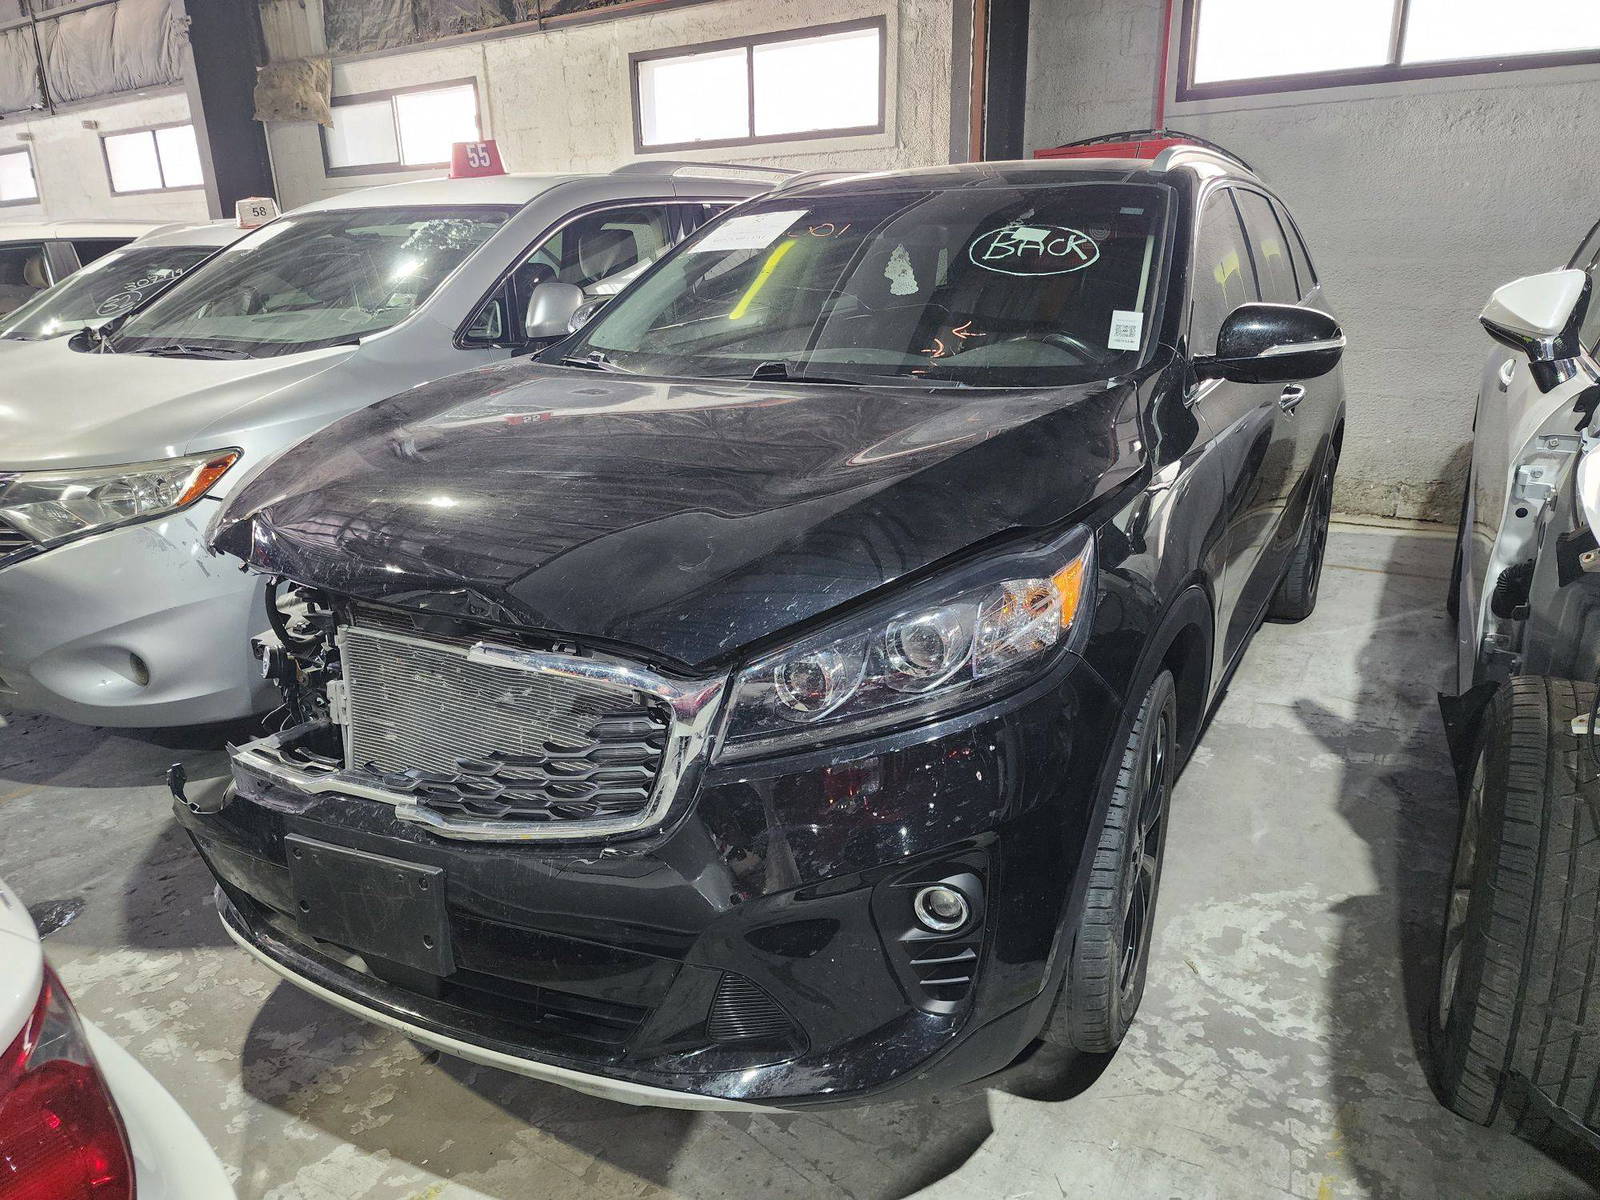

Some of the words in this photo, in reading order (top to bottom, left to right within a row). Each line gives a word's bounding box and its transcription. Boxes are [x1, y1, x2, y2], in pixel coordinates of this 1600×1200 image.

[466, 143, 491, 168] 55
[252, 206, 267, 217] 58
[982, 230, 1088, 261] BACK
